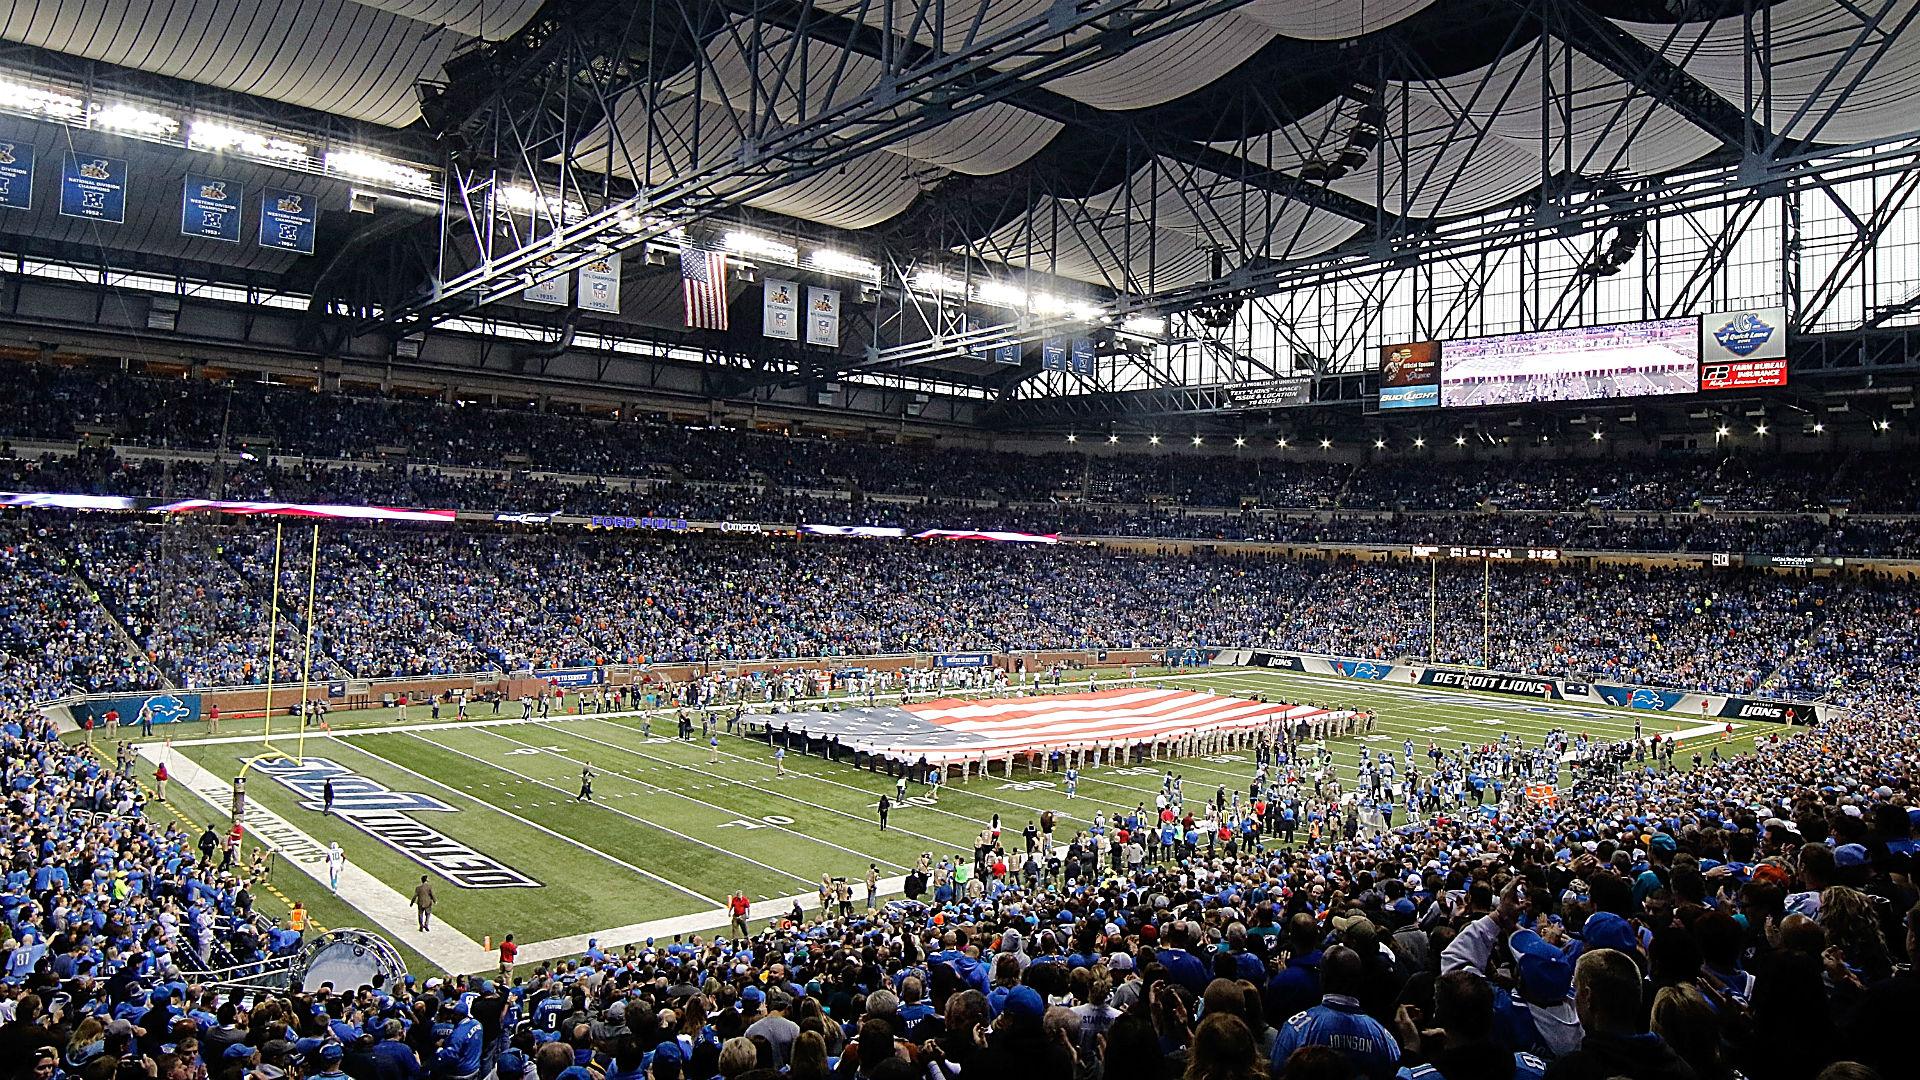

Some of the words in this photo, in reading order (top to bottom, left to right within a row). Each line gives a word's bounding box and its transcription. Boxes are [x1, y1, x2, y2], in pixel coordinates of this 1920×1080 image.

[68, 177, 95, 187] NATIONAL
[96, 182, 120, 190] DIVISION
[78, 184, 110, 193] CHAMPIONS
[190, 199, 215, 207] WESTERN
[215, 202, 236, 210] DIVISION
[198, 204, 228, 213] CHAMPIONS
[267, 211, 290, 219] WESTERN
[290, 214, 311, 223] DIVISION
[275, 217, 302, 226] CHAMPIONS
[1754, 361, 1786, 370] BUREAU
[1737, 369, 1780, 378] INSURANCE
[1263, 391, 1297, 399] LOCATION
[1408, 392, 1438, 400] LIGHT
[592, 517, 636, 528] FORD
[641, 518, 687, 530] FIELD
[1267, 656, 1292, 667] LIONS
[1433, 672, 1499, 691] DETROIT
[1499, 679, 1546, 694] LIONS
[1739, 704, 1783, 718] LIONS
[716, 815, 796, 830] 10
[346, 811, 536, 887] DETROIT
[332, 852, 339, 861] 10
[16, 952, 30, 966] 81
[548, 1012, 557, 1029] 9
[1287, 1010, 1312, 1032] 81
[1329, 1034, 1372, 1054] JOHNSON
